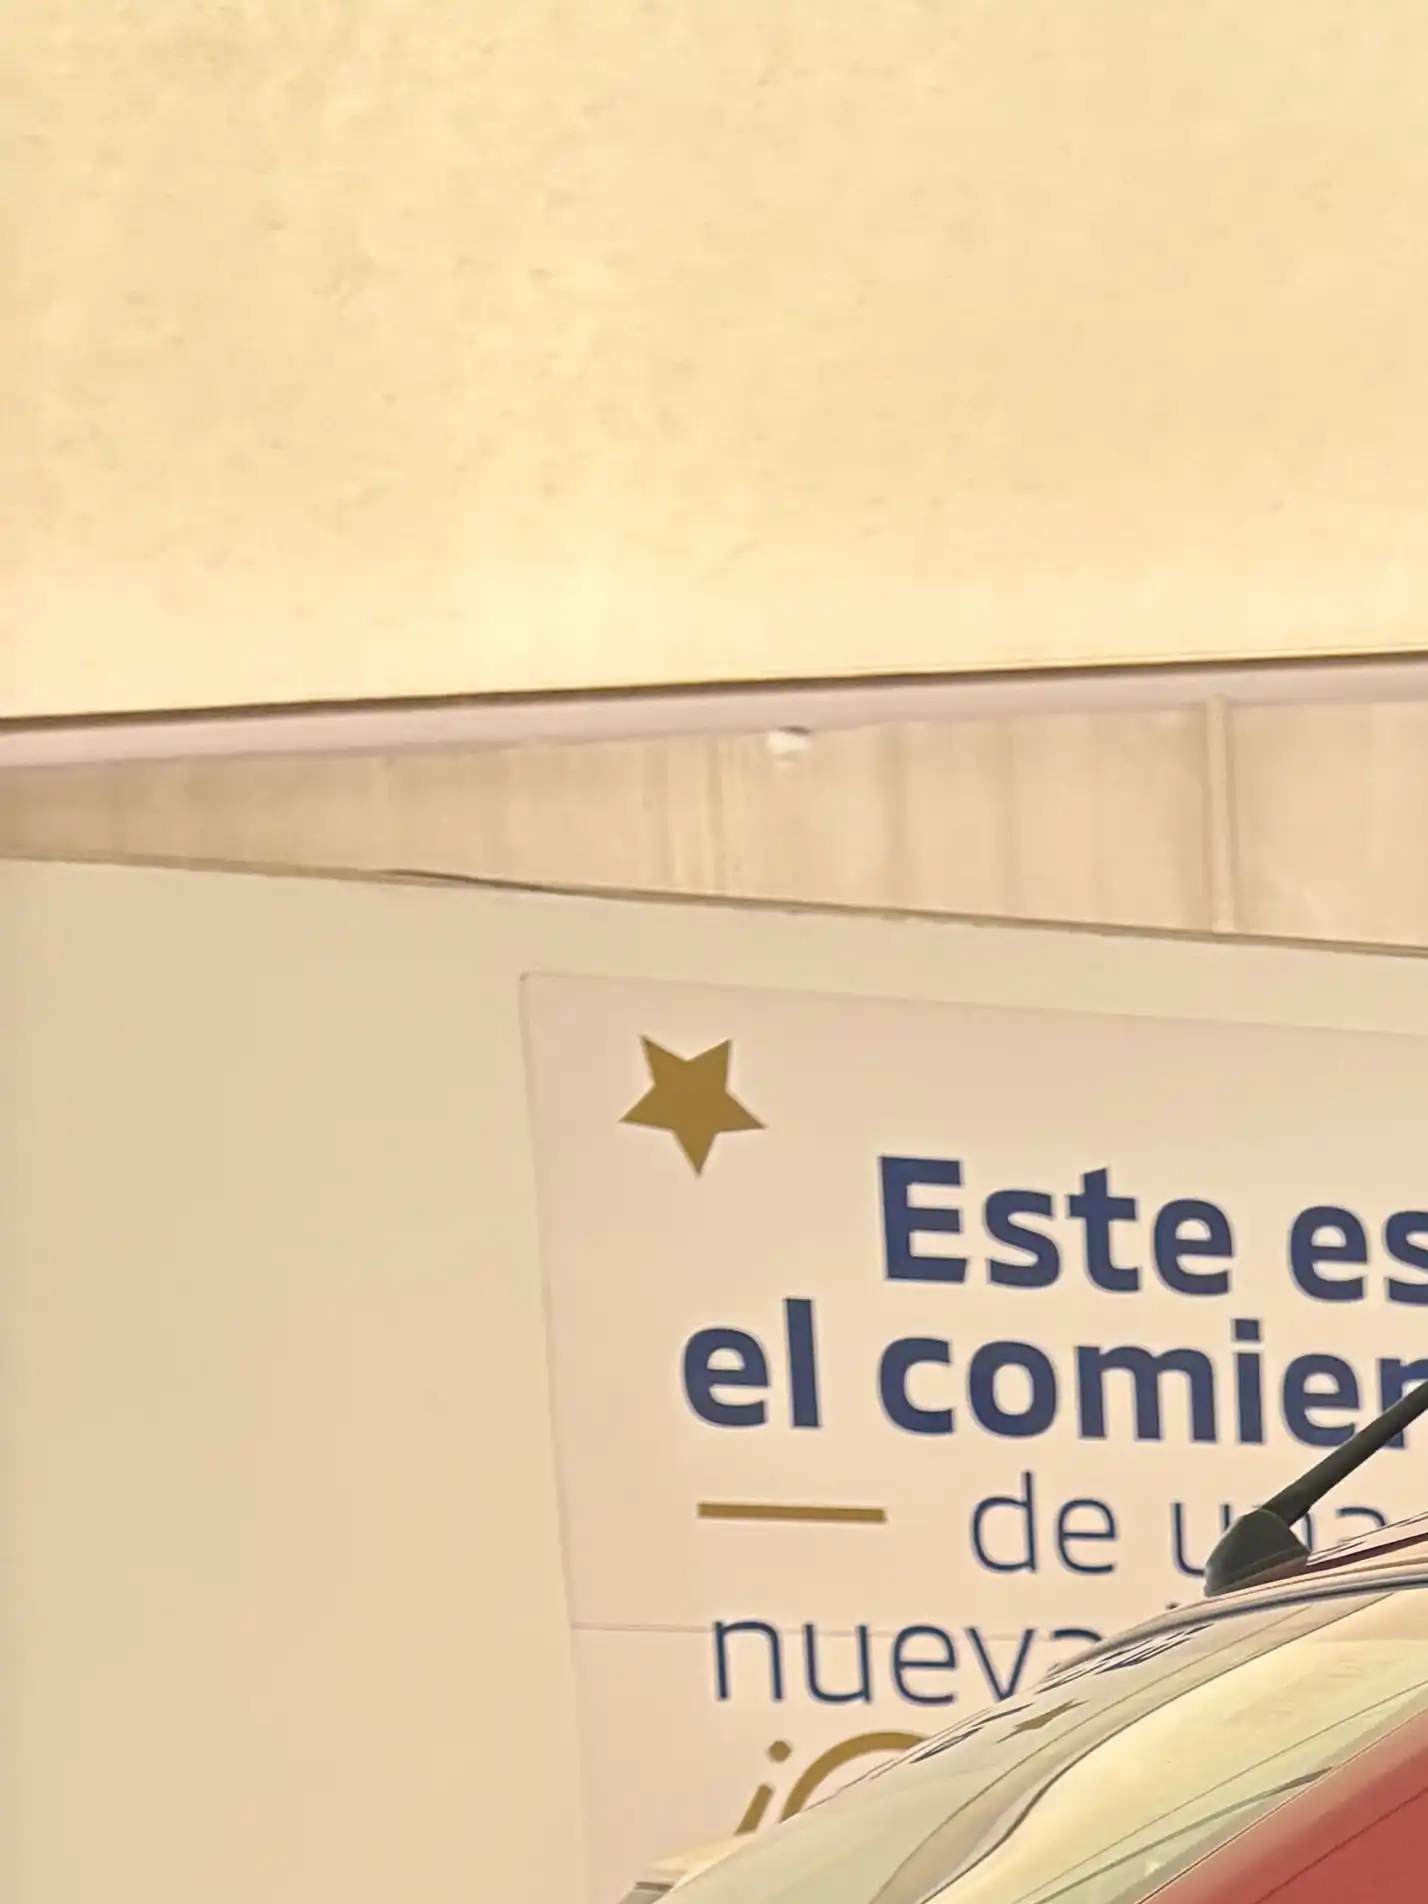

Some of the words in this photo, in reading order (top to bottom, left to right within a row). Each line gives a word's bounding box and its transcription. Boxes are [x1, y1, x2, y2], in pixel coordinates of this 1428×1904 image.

[878, 1154, 1235, 1297] Este
[682, 1297, 821, 1430] el
[971, 1471, 1116, 1575] de
[712, 1618, 1103, 1706] nuev
